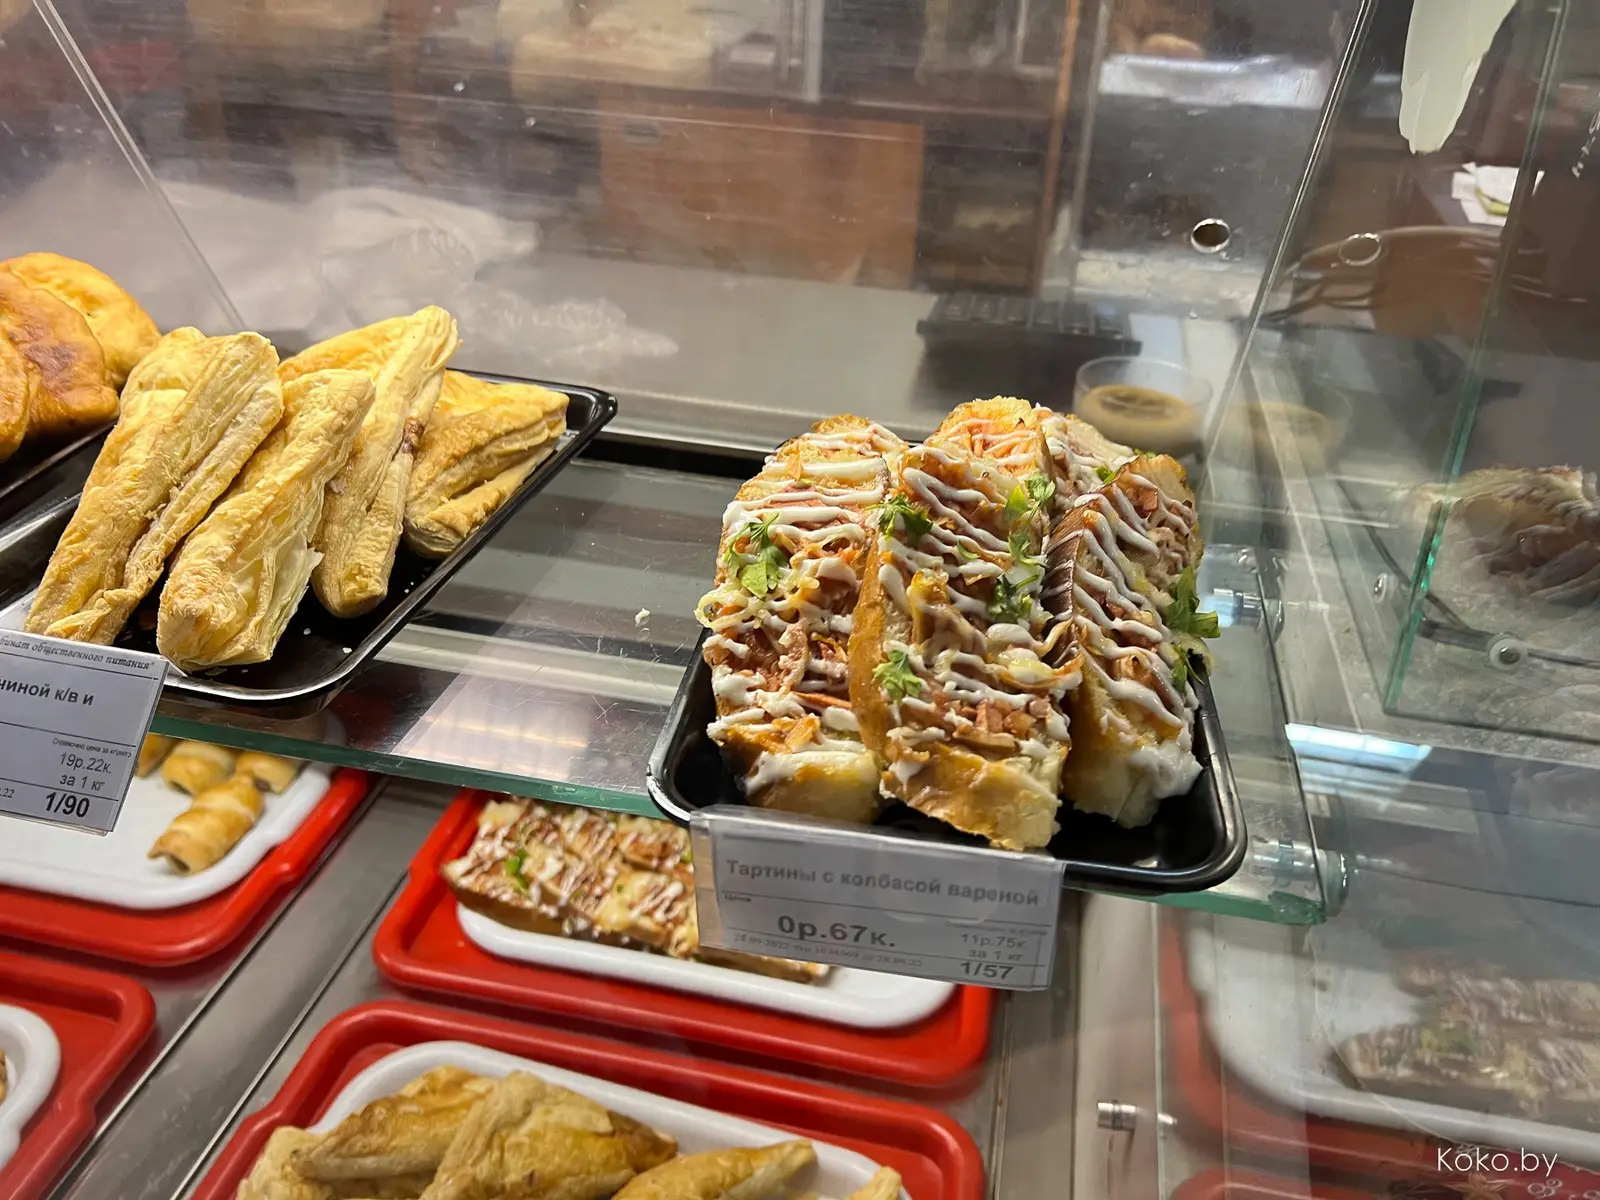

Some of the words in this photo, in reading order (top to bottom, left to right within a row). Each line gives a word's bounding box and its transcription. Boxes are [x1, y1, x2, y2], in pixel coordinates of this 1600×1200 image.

[32, 642, 103, 663] общественного
[54, 687, 79, 704] к/в
[82, 694, 94, 706] и
[60, 752, 112, 774] 19р.22к.
[60, 775, 76, 787] за
[81, 776, 88, 789] 1
[91, 781, 105, 792] кг
[46, 792, 90, 818] 1/90
[726, 859, 816, 883] Тартины
[822, 871, 834, 884] с
[841, 873, 941, 896] колбасой
[948, 886, 1040, 906] вареной
[778, 915, 896, 948] 0р.67к.
[968, 949, 987, 959] за
[994, 950, 1001, 960] 1
[1008, 953, 1024, 962] кг
[960, 961, 1015, 980] 1/57
